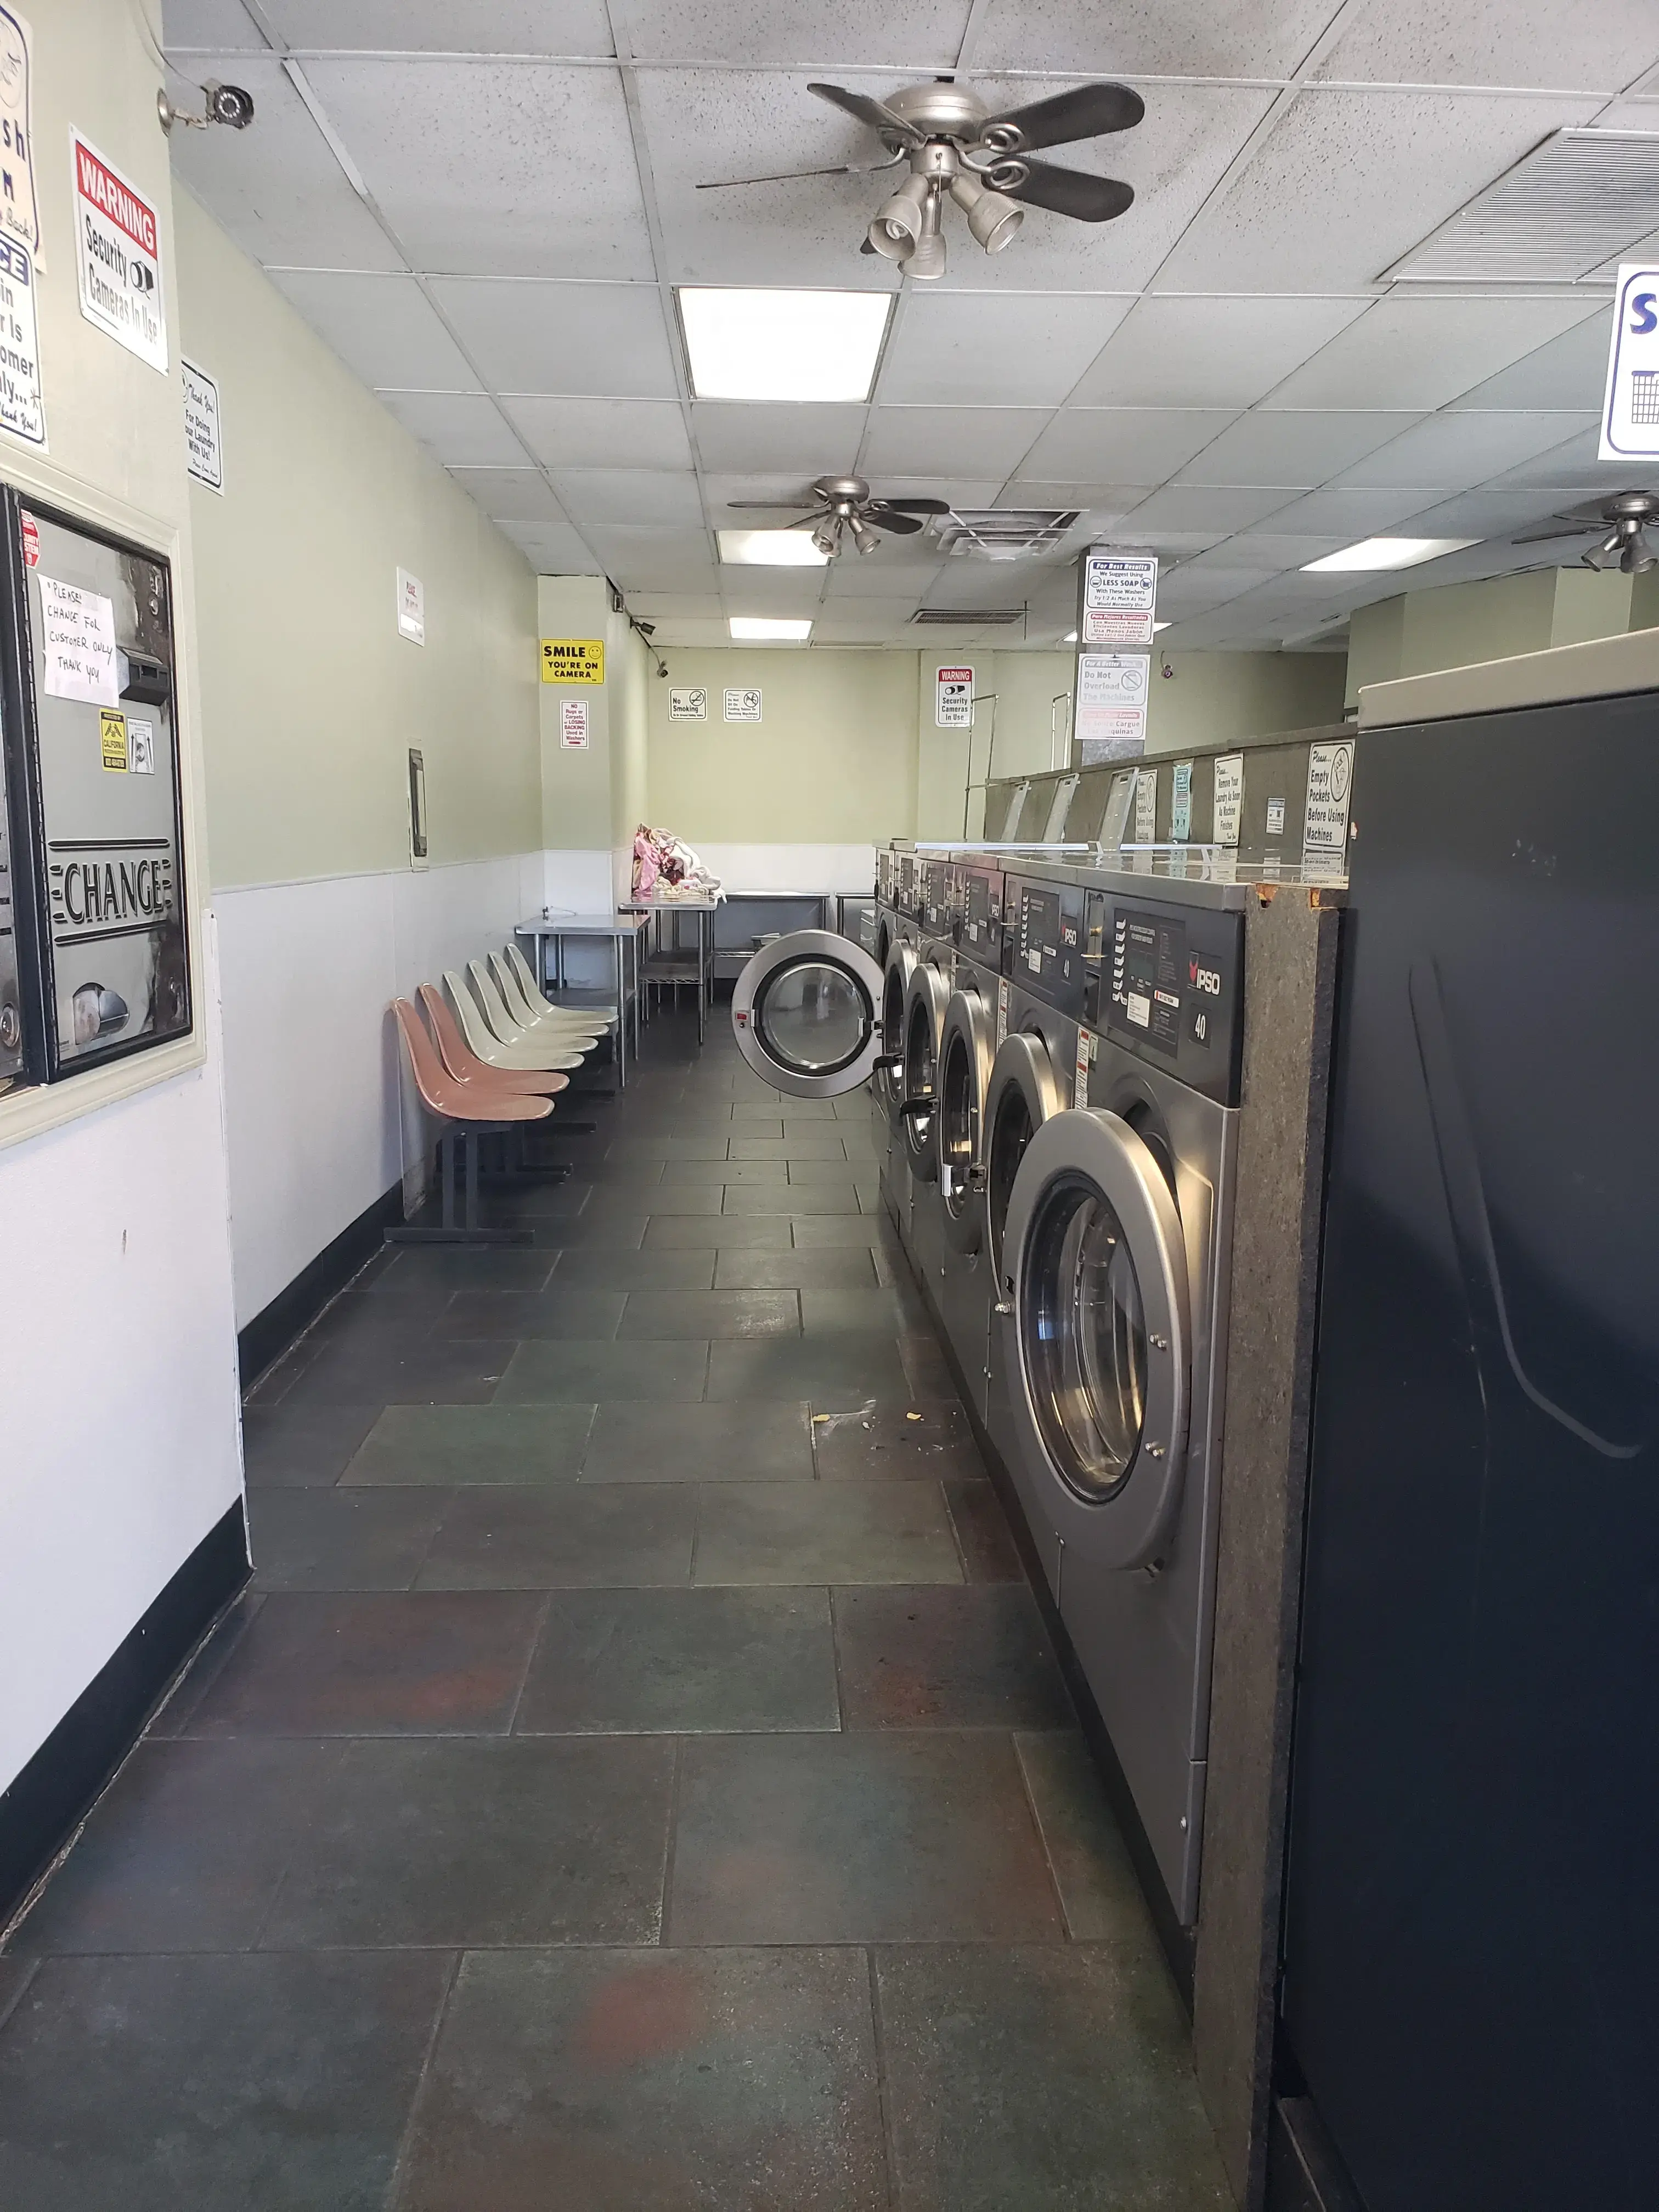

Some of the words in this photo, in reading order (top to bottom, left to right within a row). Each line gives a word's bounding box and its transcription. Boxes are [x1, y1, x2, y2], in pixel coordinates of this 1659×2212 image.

[80, 152, 154, 251] WARNING
[86, 213, 127, 287] Security
[89, 262, 129, 325] Cameras
[131, 296, 140, 332] In
[142, 305, 157, 346] Use
[195, 415, 210, 437] Doing
[188, 438, 200, 456] With
[201, 446, 210, 461] Us!
[194, 428, 215, 453] Laundry
[48, 605, 78, 623] CHANGE
[84, 616, 100, 631] FOR
[49, 631, 89, 649] CUSTOMER
[93, 641, 113, 665] ONLY
[544, 646, 585, 657] SMILE
[58, 656, 81, 673] THANK
[941, 671, 970, 680] WARNING
[943, 697, 968, 706] Security
[1100, 693, 1135, 701] Machines
[673, 705, 698, 713] Smoking
[1311, 769, 1329, 786] Empty
[1309, 788, 1330, 803] Pockets
[1307, 808, 1327, 821] Before
[1328, 808, 1345, 826] Using
[1306, 826, 1333, 842] Machines
[63, 859, 163, 924] CHANGE
[1197, 968, 1221, 996] IPSO
[1194, 1013, 1206, 1041] 40
